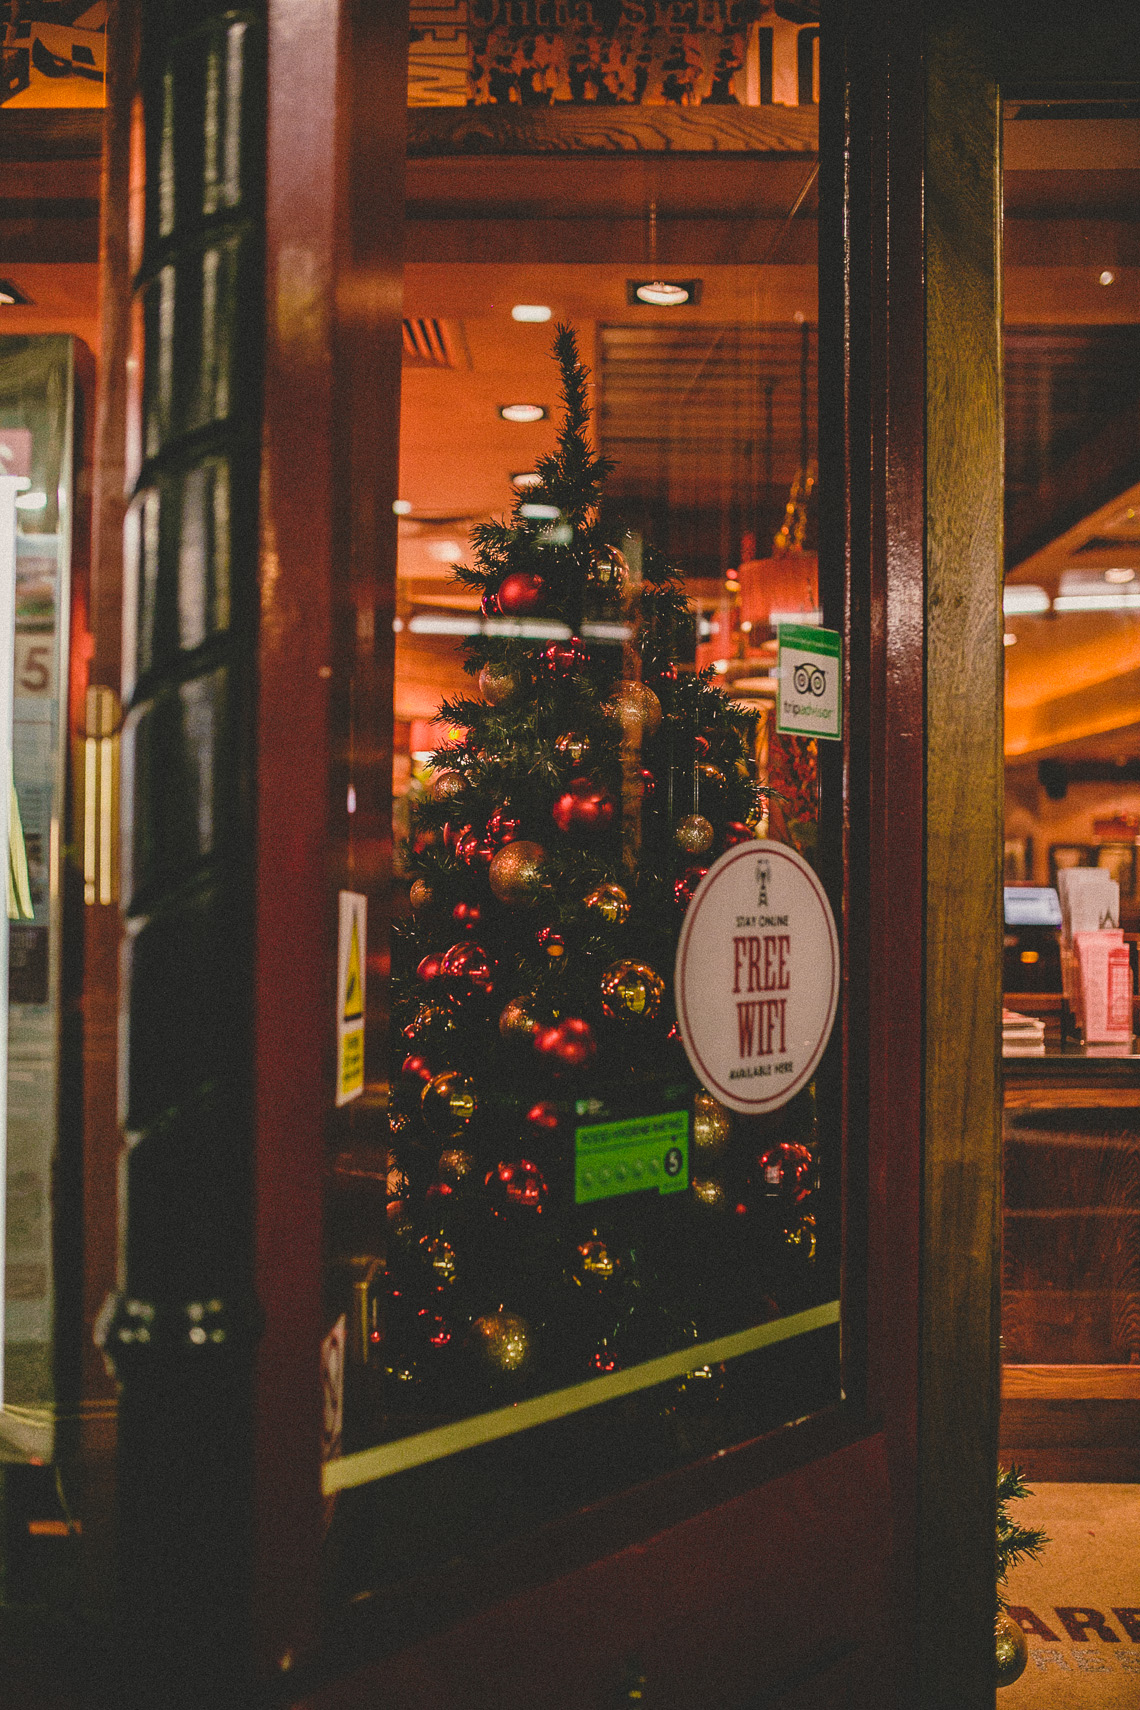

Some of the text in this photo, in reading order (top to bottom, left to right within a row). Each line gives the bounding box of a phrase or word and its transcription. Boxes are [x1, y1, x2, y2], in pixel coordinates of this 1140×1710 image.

[736, 915, 789, 928] STAY ONLINE
[733, 935, 790, 993] FREE
[736, 999, 787, 1058] WIFI
